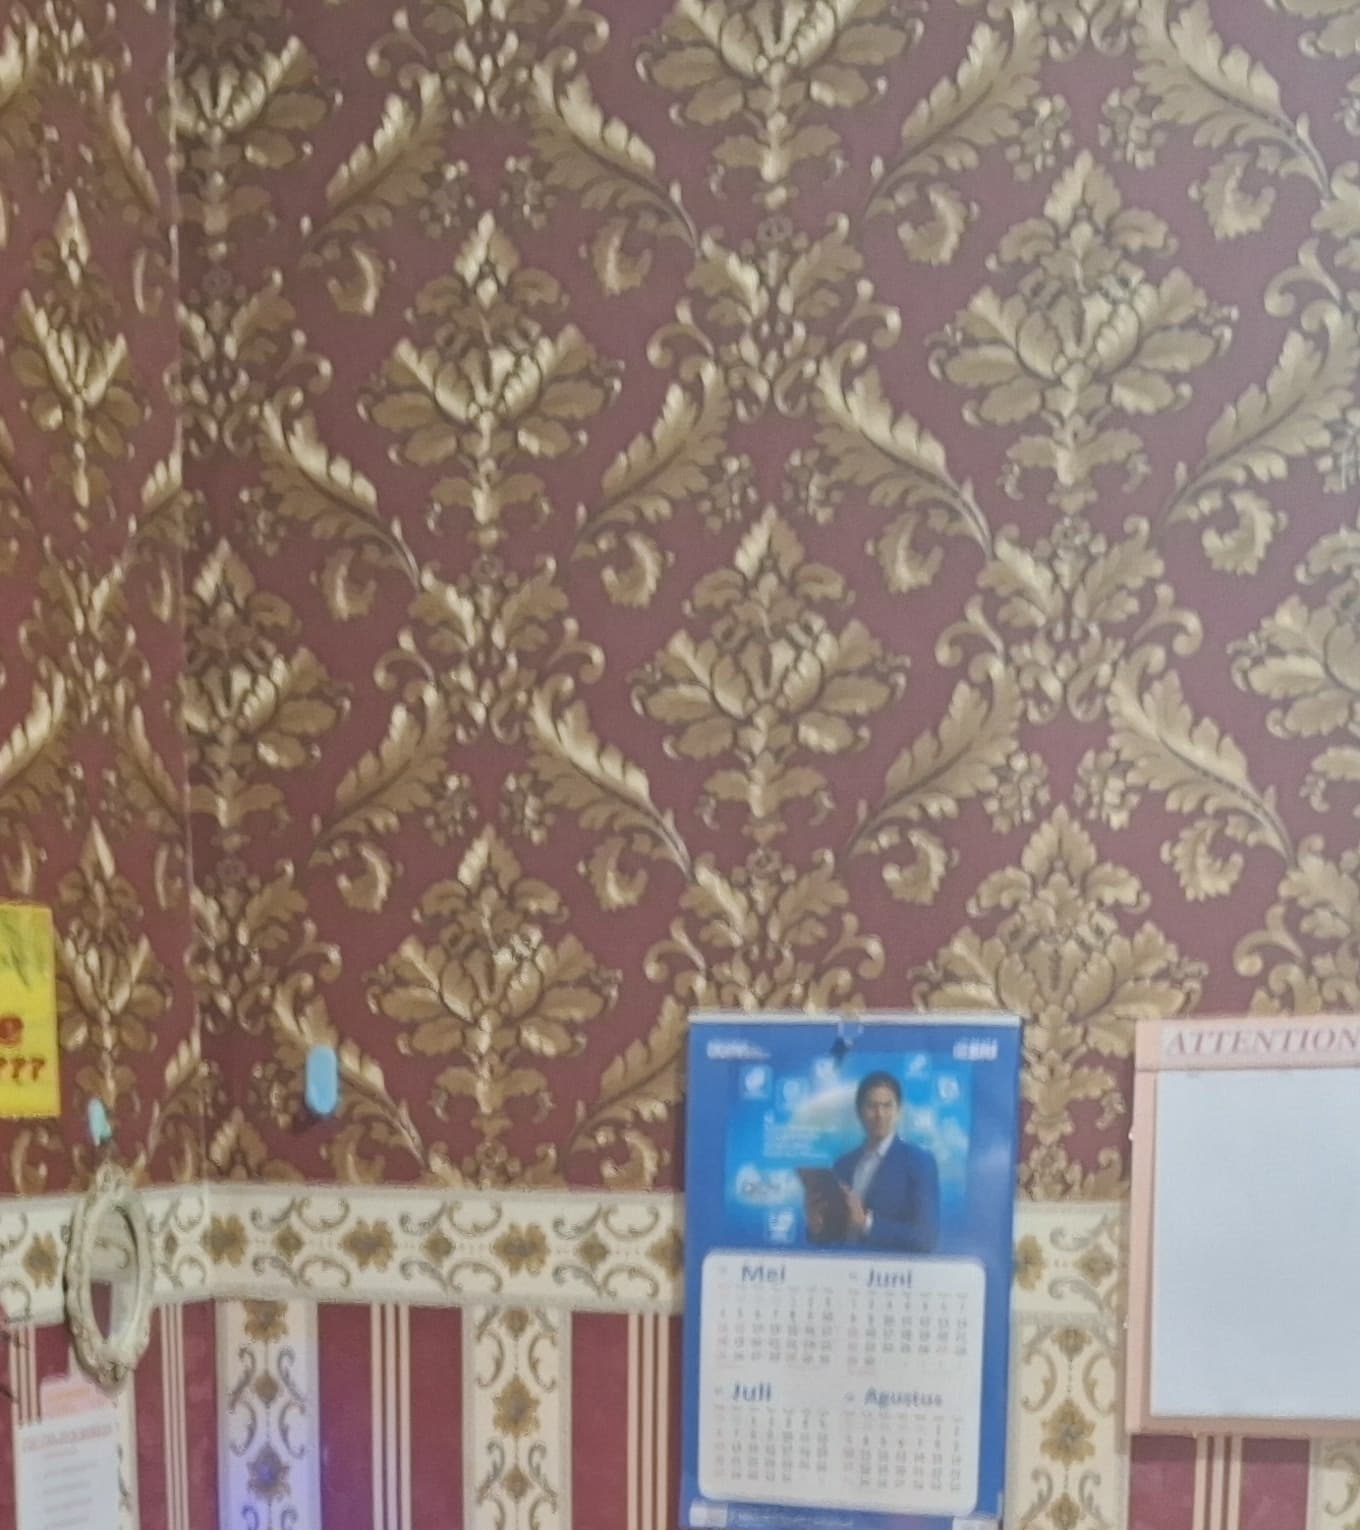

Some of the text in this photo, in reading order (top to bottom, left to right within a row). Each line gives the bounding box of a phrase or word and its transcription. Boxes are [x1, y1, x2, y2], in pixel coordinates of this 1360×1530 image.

[1166, 1027, 1360, 1056] ATTENTION
[741, 1264, 786, 1283] Mei
[867, 1269, 912, 1289] Juni
[732, 1382, 772, 1402] Juli
